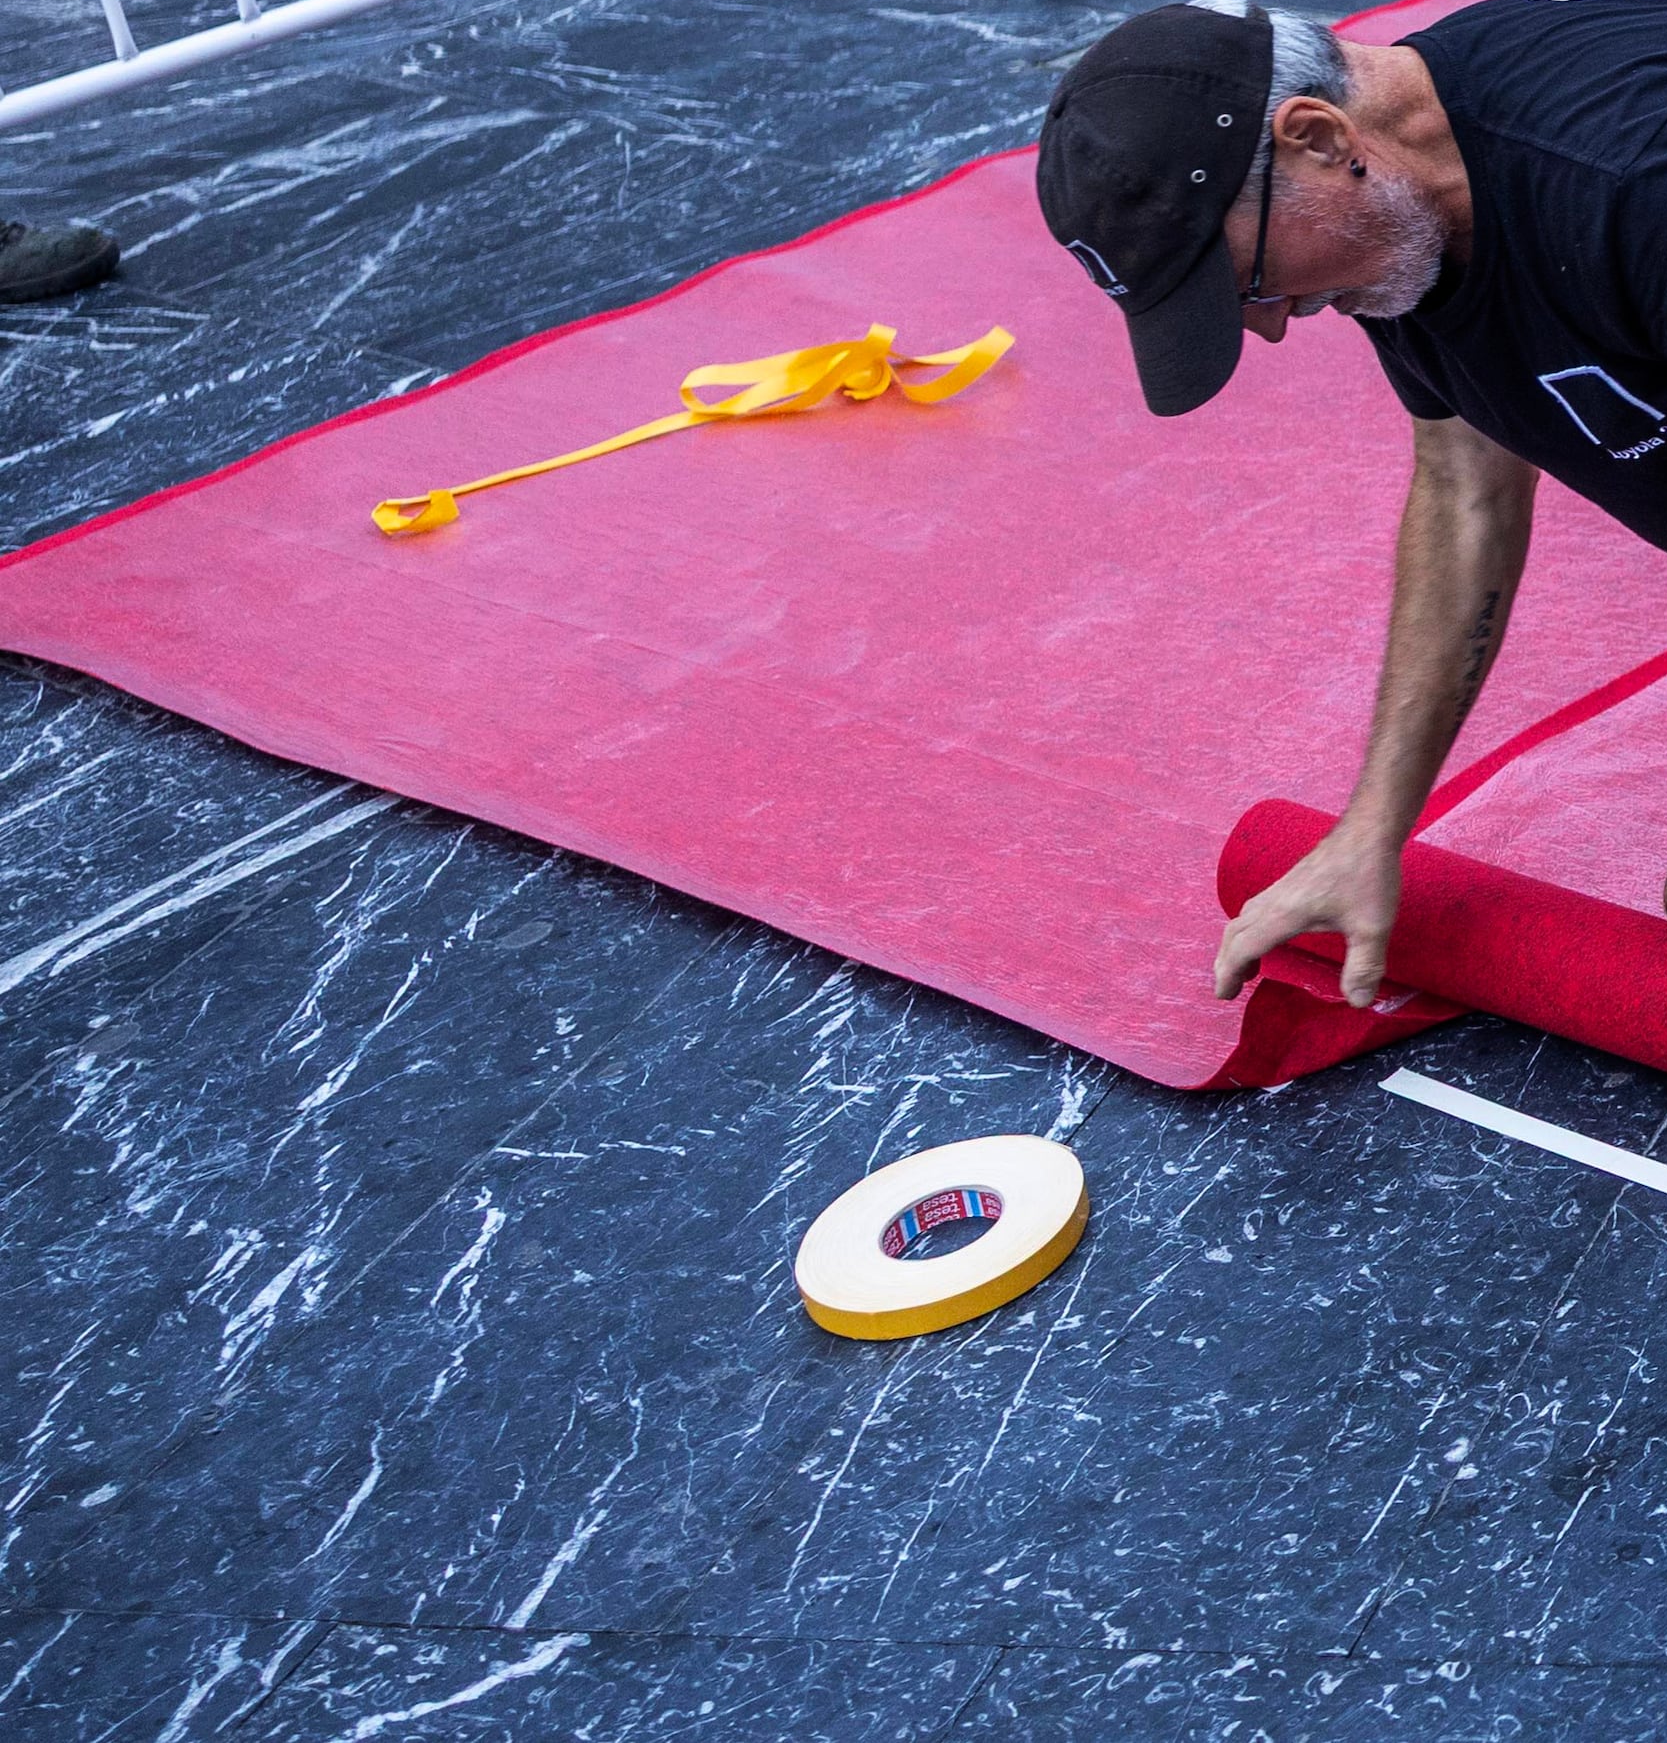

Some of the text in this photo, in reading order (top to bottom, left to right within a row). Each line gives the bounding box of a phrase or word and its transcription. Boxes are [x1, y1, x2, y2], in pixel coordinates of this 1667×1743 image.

[1606, 435, 1666, 460] Loyola
[923, 1193, 958, 1211] tesa
[924, 1203, 961, 1222] tesa
